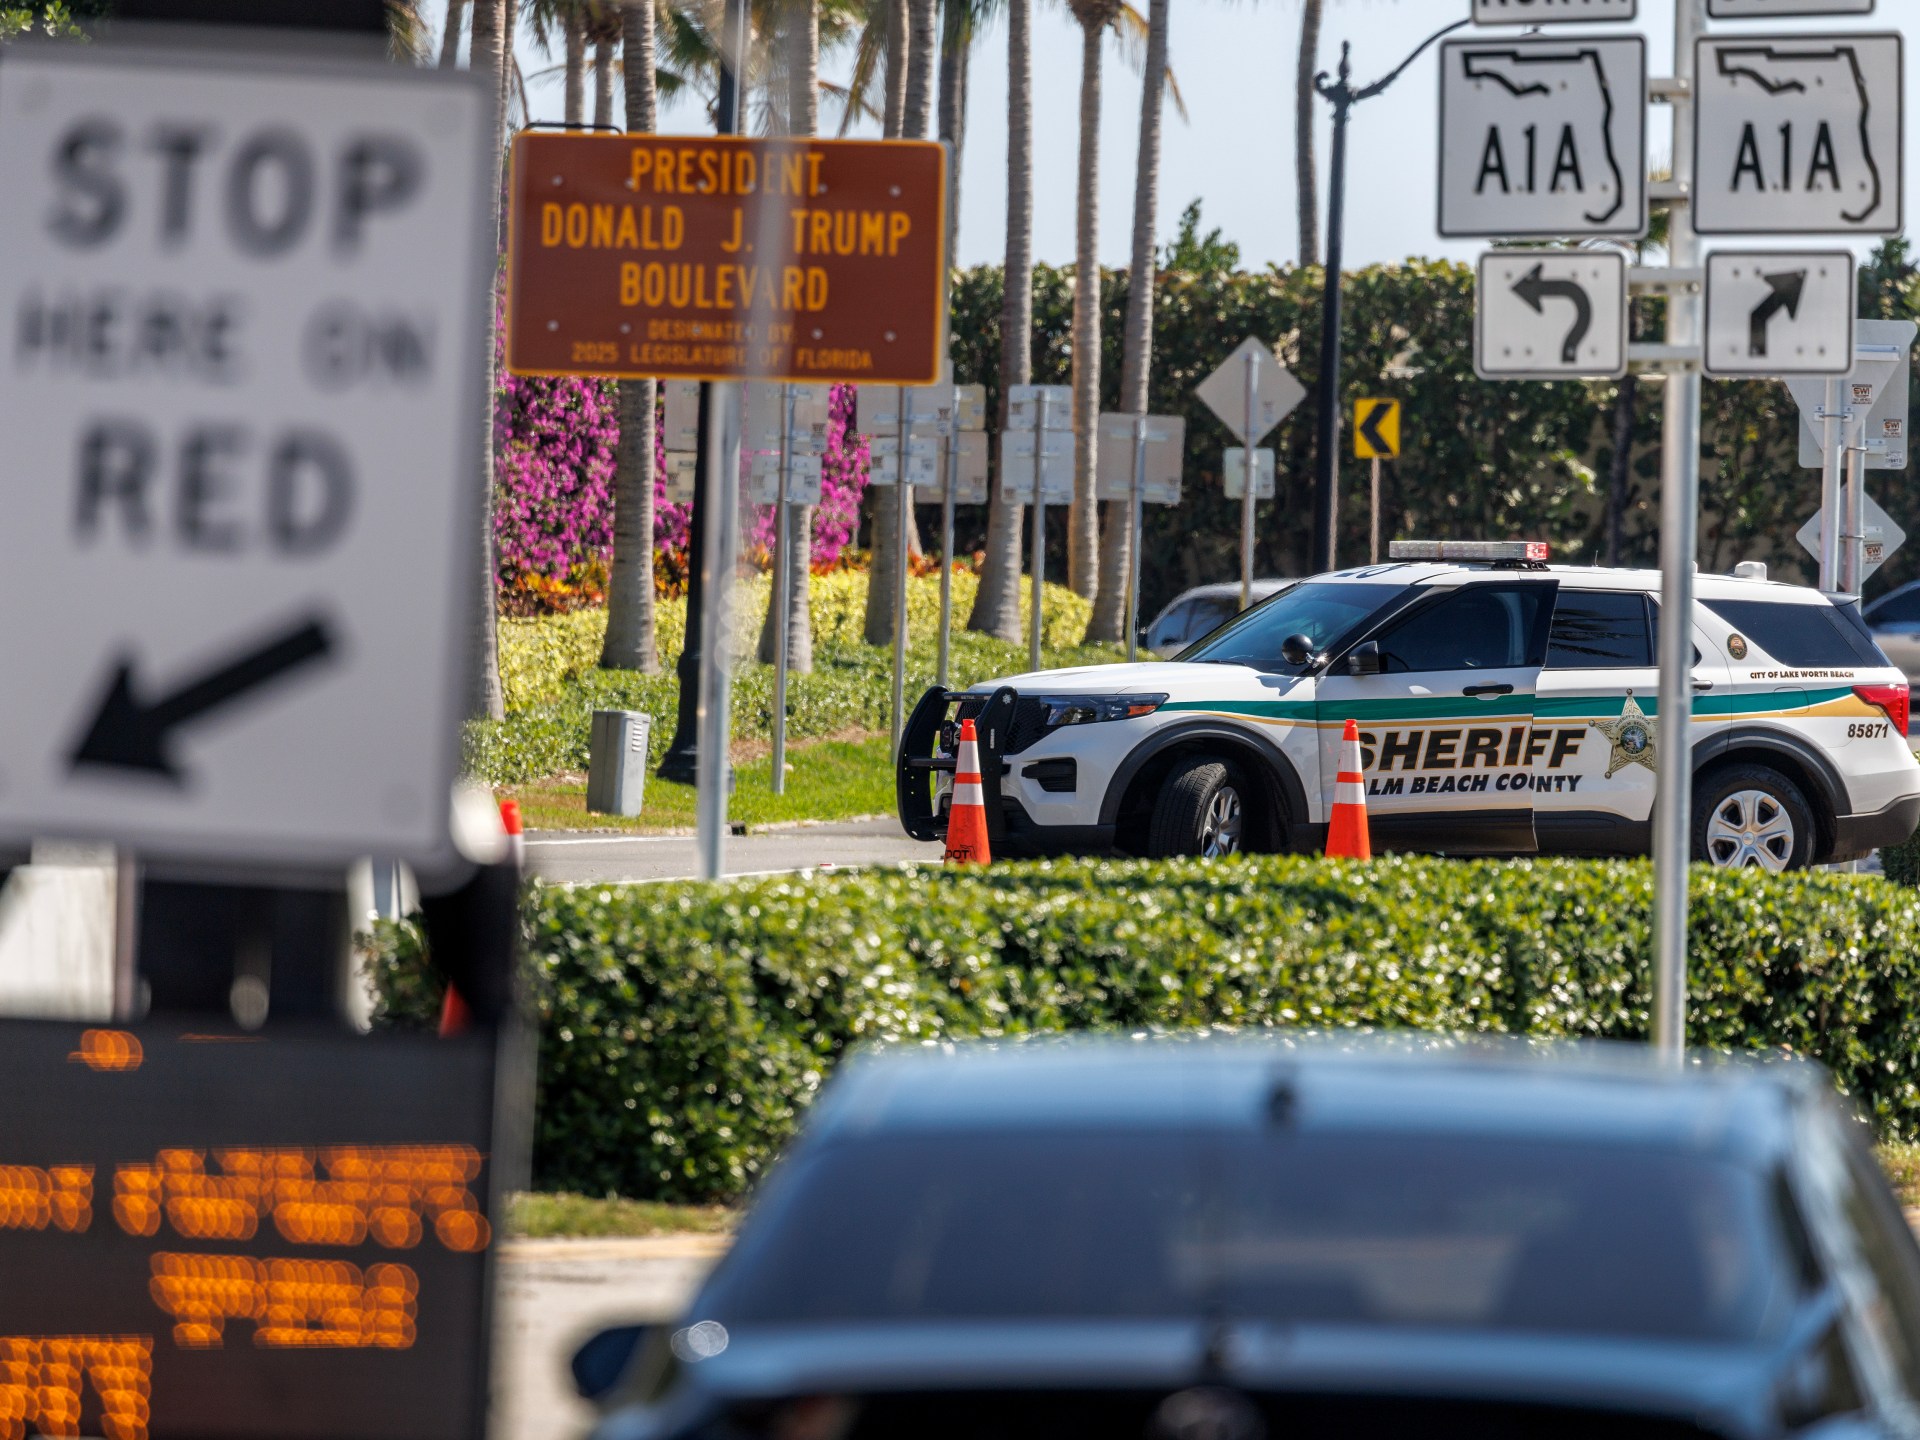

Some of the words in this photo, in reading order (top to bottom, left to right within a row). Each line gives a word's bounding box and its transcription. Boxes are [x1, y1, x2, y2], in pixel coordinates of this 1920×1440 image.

[631, 147, 825, 198] PRESIDENT
[1474, 122, 1585, 195] A1A
[1728, 119, 1841, 193] A1A
[44, 115, 426, 264] STOP
[541, 203, 685, 251] DONALD
[720, 208, 754, 254] J.
[790, 209, 911, 256] TRUMP
[620, 262, 829, 312] BOULEVARD
[14, 288, 242, 386] HERE
[302, 301, 438, 392] ON
[648, 319, 758, 342] DESIGNATED
[630, 343, 746, 368] LEGISLATURE
[797, 348, 874, 370] FLORIDA
[74, 413, 358, 560] RED
[1750, 671, 1766, 679] CITY
[1800, 670, 1828, 678] WORTH
[1359, 726, 1587, 772] SHERIFF
[1847, 723, 1889, 739] 85871
[1409, 774, 1490, 795] BEACH
[1495, 773, 1583, 794] COUNTY
